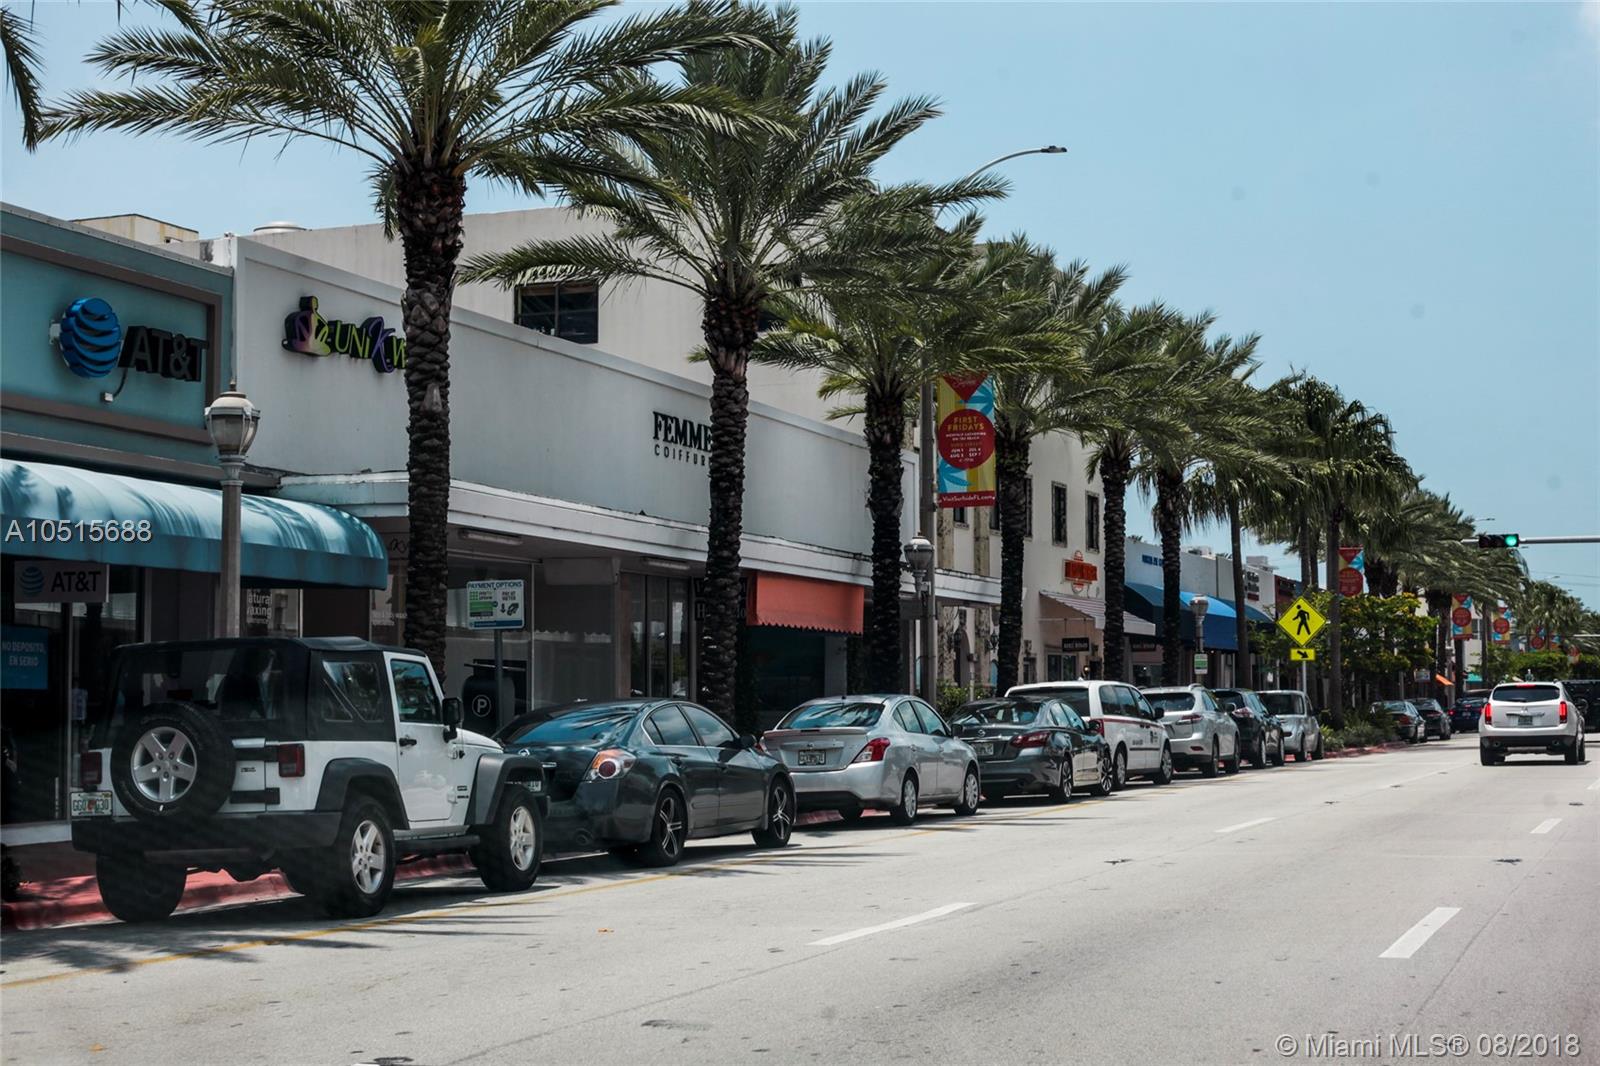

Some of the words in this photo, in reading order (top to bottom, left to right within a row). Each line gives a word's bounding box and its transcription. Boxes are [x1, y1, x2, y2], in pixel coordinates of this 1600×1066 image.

[118, 325, 209, 382] AT&T
[953, 416, 977, 424] FIRST
[947, 423, 984, 431] FRIDAYS
[654, 444, 711, 466] COIFFUR
[51, 571, 101, 593] AT&T
[248, 592, 273, 605] atural
[2, 641, 11, 651] NO
[9, 655, 18, 667] EN
[19, 655, 39, 667] SERIO
[477, 699, 488, 714] P
